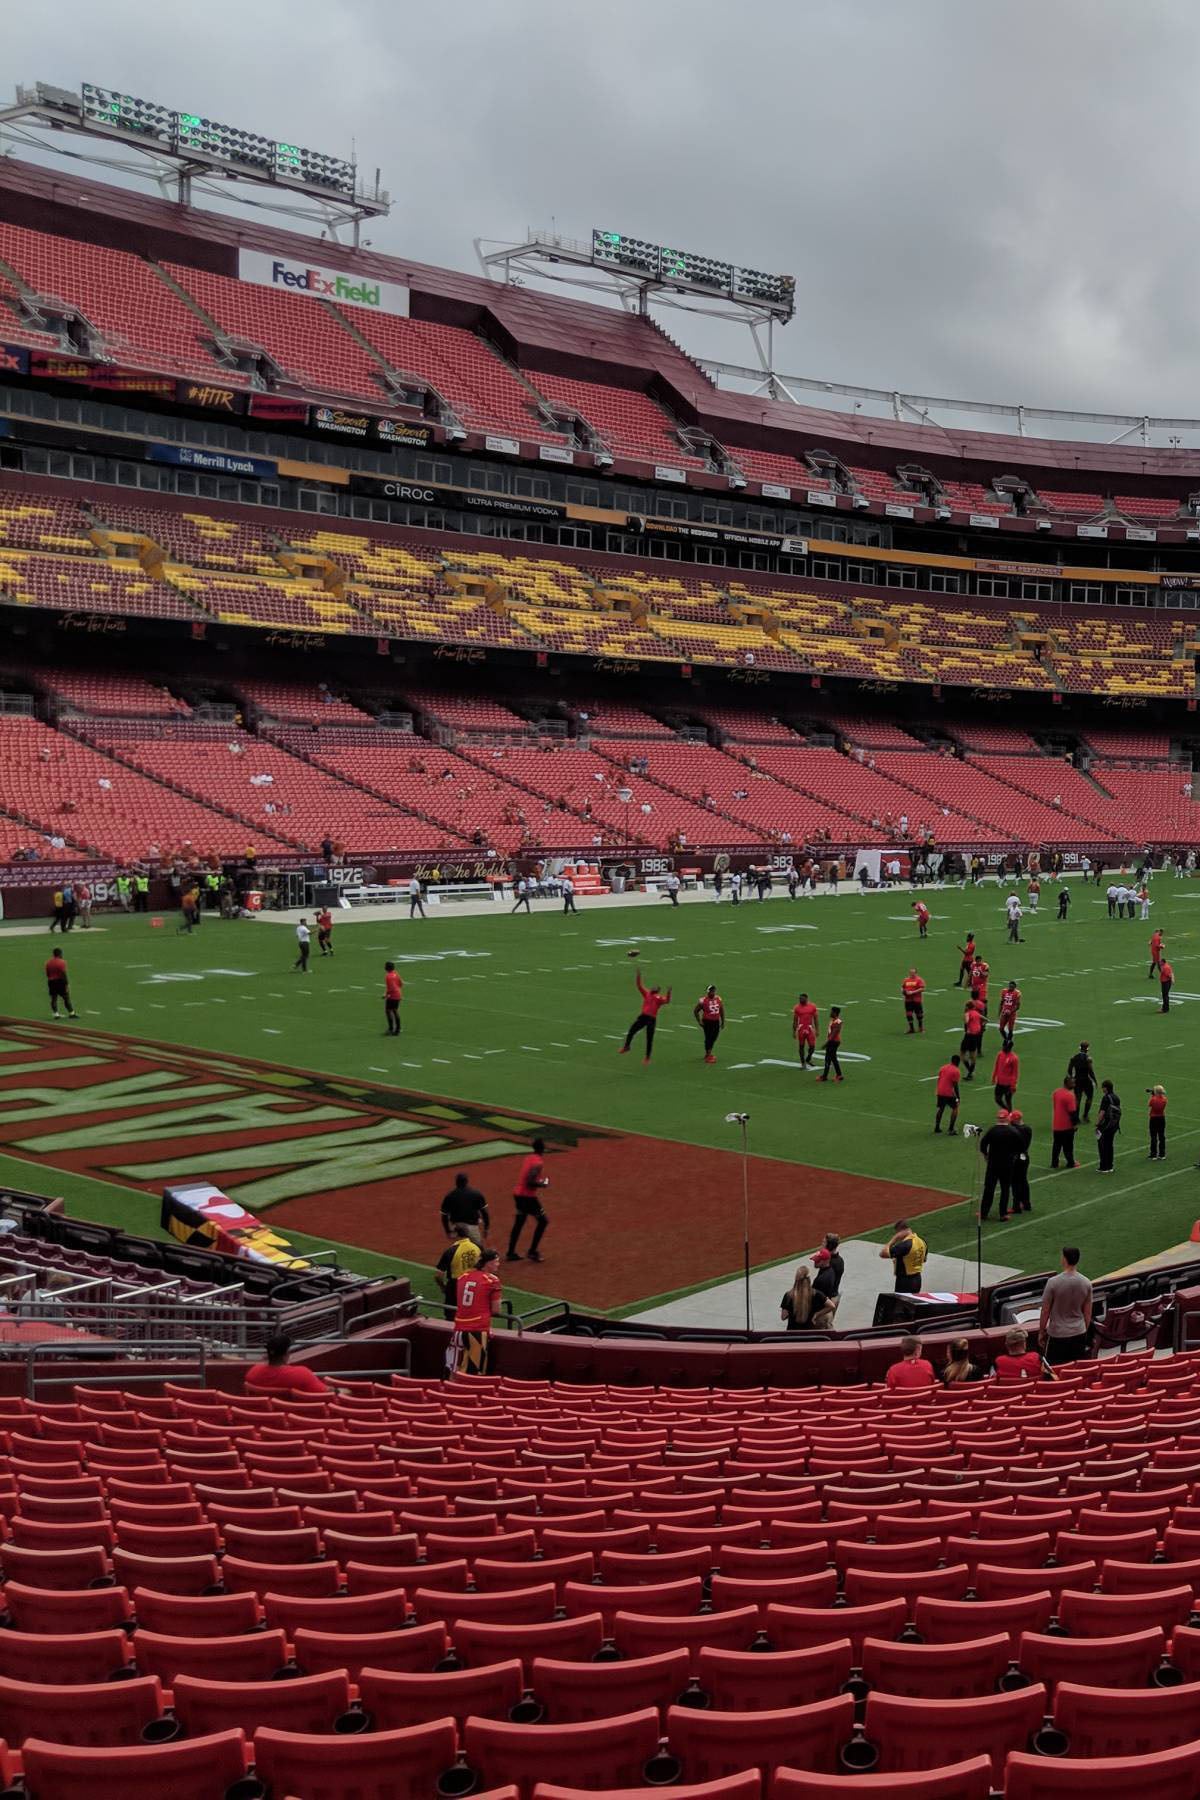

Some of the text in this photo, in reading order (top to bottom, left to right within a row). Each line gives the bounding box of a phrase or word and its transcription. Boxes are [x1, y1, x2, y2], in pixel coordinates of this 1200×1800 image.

[272, 261, 381, 307] FedExField
[332, 411, 370, 428] Sports
[317, 421, 367, 437] WASHINGTON
[394, 422, 430, 440] Sports
[379, 432, 428, 447] WASHINGTON
[193, 453, 255, 473] Merrill Lynch
[467, 497, 560, 517] ULTRA PREMIUM VODKA
[640, 859, 669, 872] 1982
[327, 868, 364, 884] 1972
[462, 1280, 476, 1307] 6
